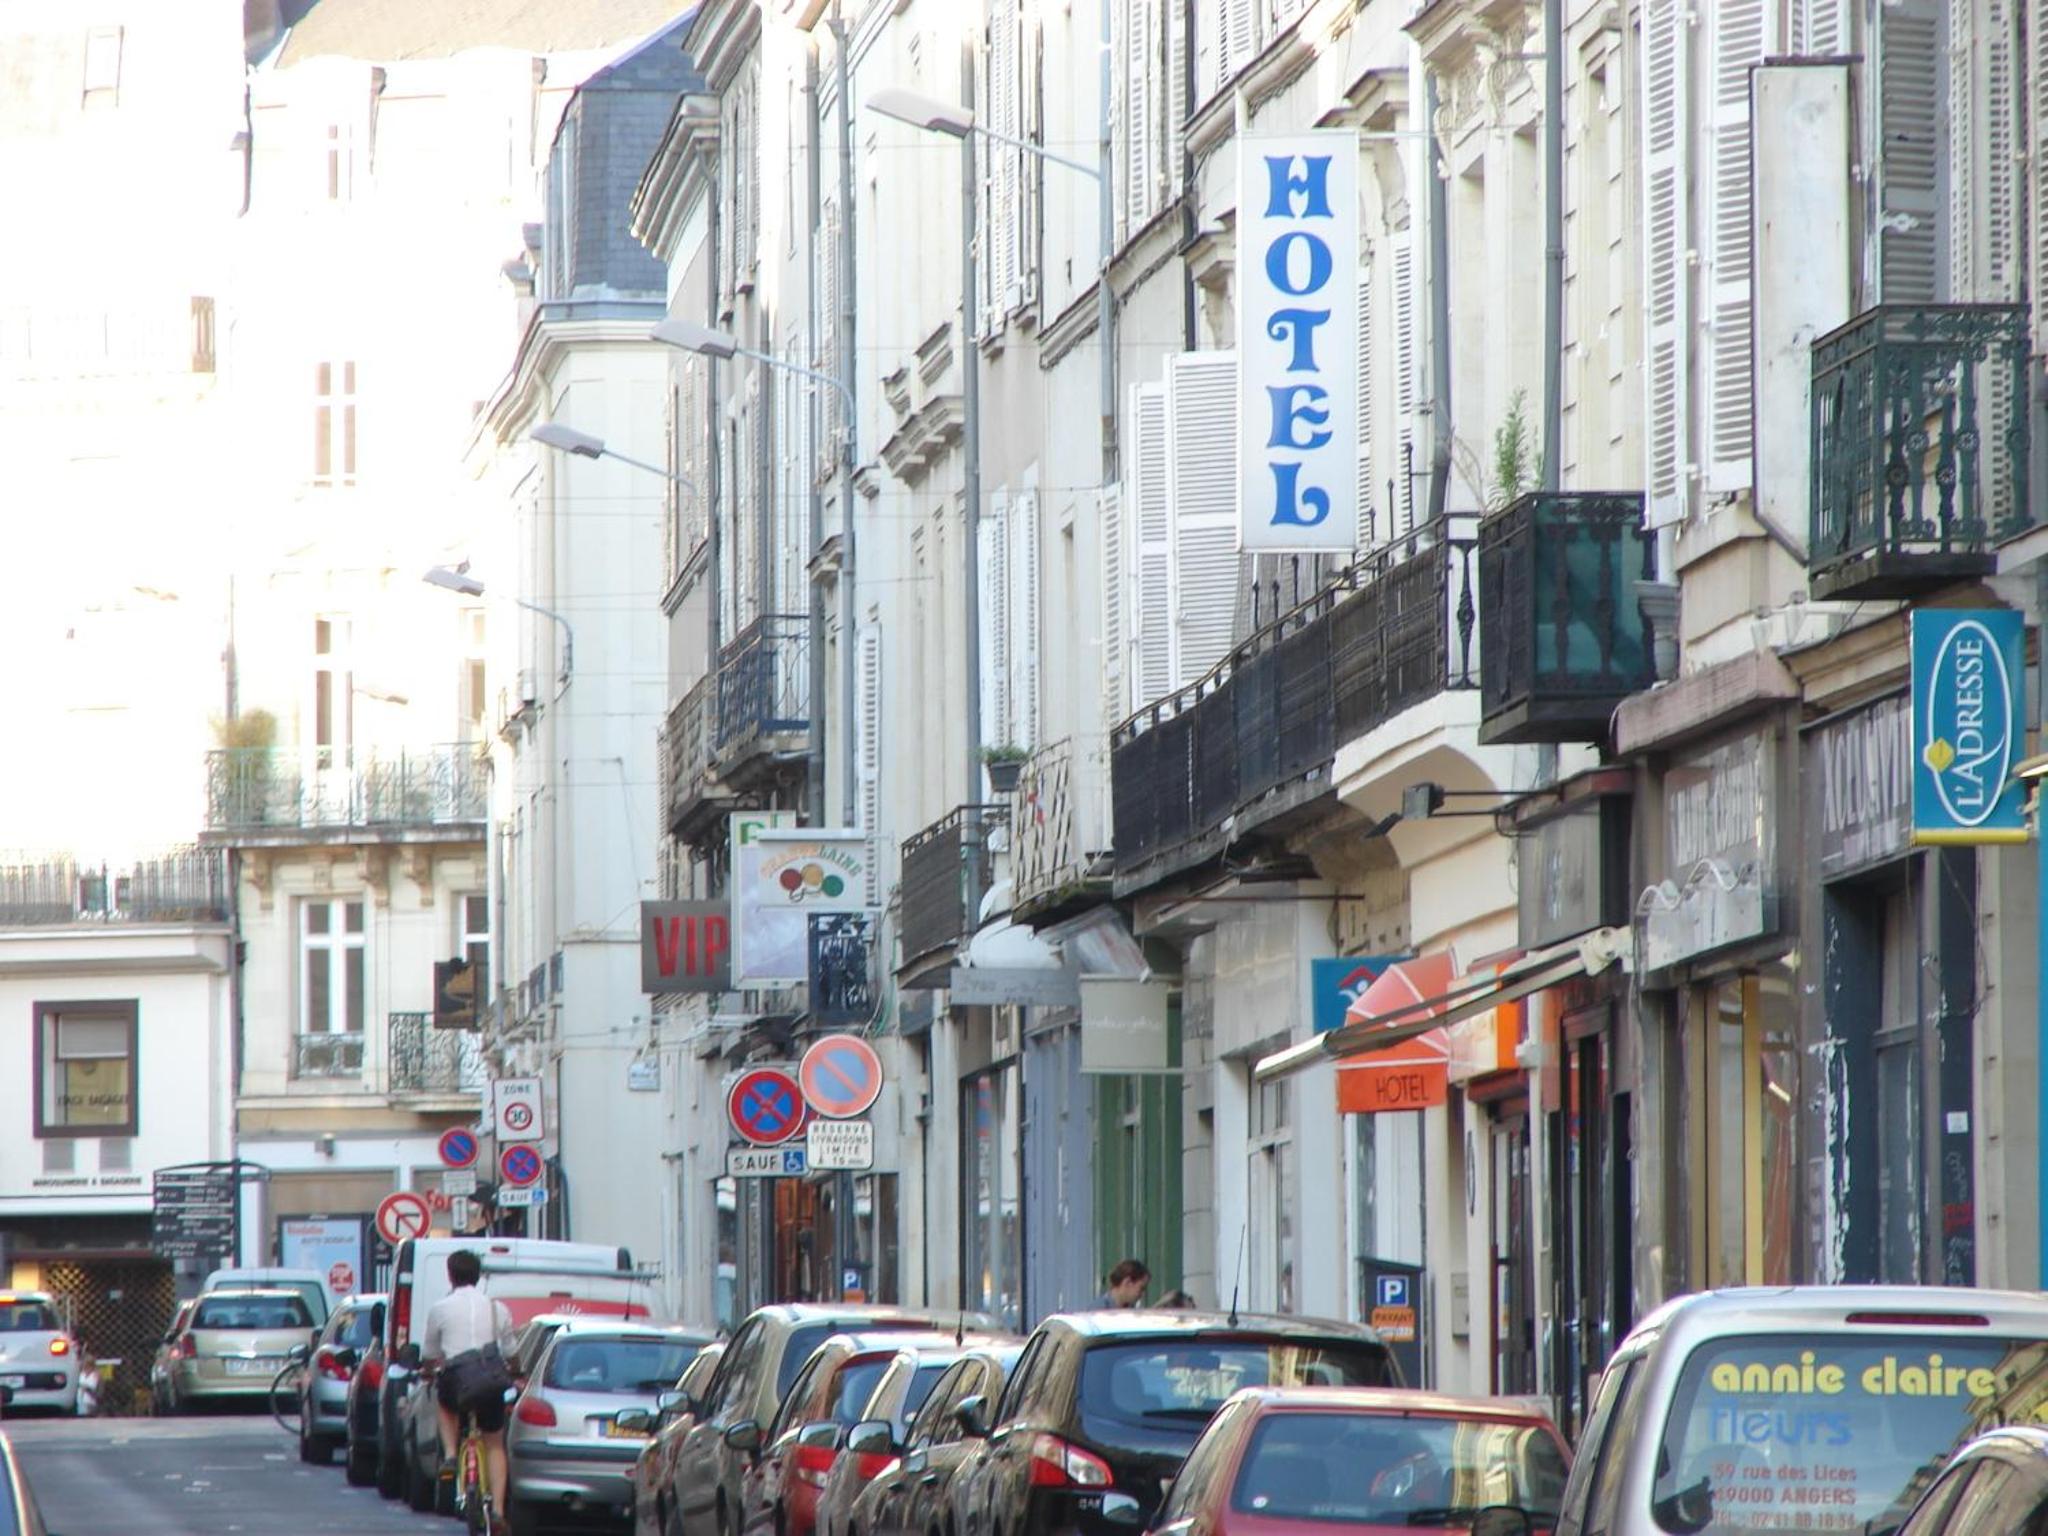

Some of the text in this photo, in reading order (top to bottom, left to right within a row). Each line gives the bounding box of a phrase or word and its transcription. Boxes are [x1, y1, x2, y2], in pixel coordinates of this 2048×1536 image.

[1263, 154, 1335, 528] HOTEL
[1952, 637, 1988, 808] L'ADRESSE
[653, 913, 729, 977] VIP
[503, 1084, 531, 1095] ZONE
[1375, 1073, 1429, 1103] HOTEL
[510, 1108, 527, 1124] 30
[733, 1152, 778, 1170] SAUF
[501, 1192, 529, 1203] SAUF
[1384, 1279, 1403, 1303] P
[1375, 1312, 1413, 1322] PAYANT
[1711, 1350, 1996, 1397] annie claire
[1710, 1399, 1853, 1446] fleurs
[1742, 1465, 1771, 1480] rue
[1777, 1464, 1807, 1480] des
[1814, 1464, 1857, 1480] Lices
[1780, 1487, 1857, 1504] ANGERS
